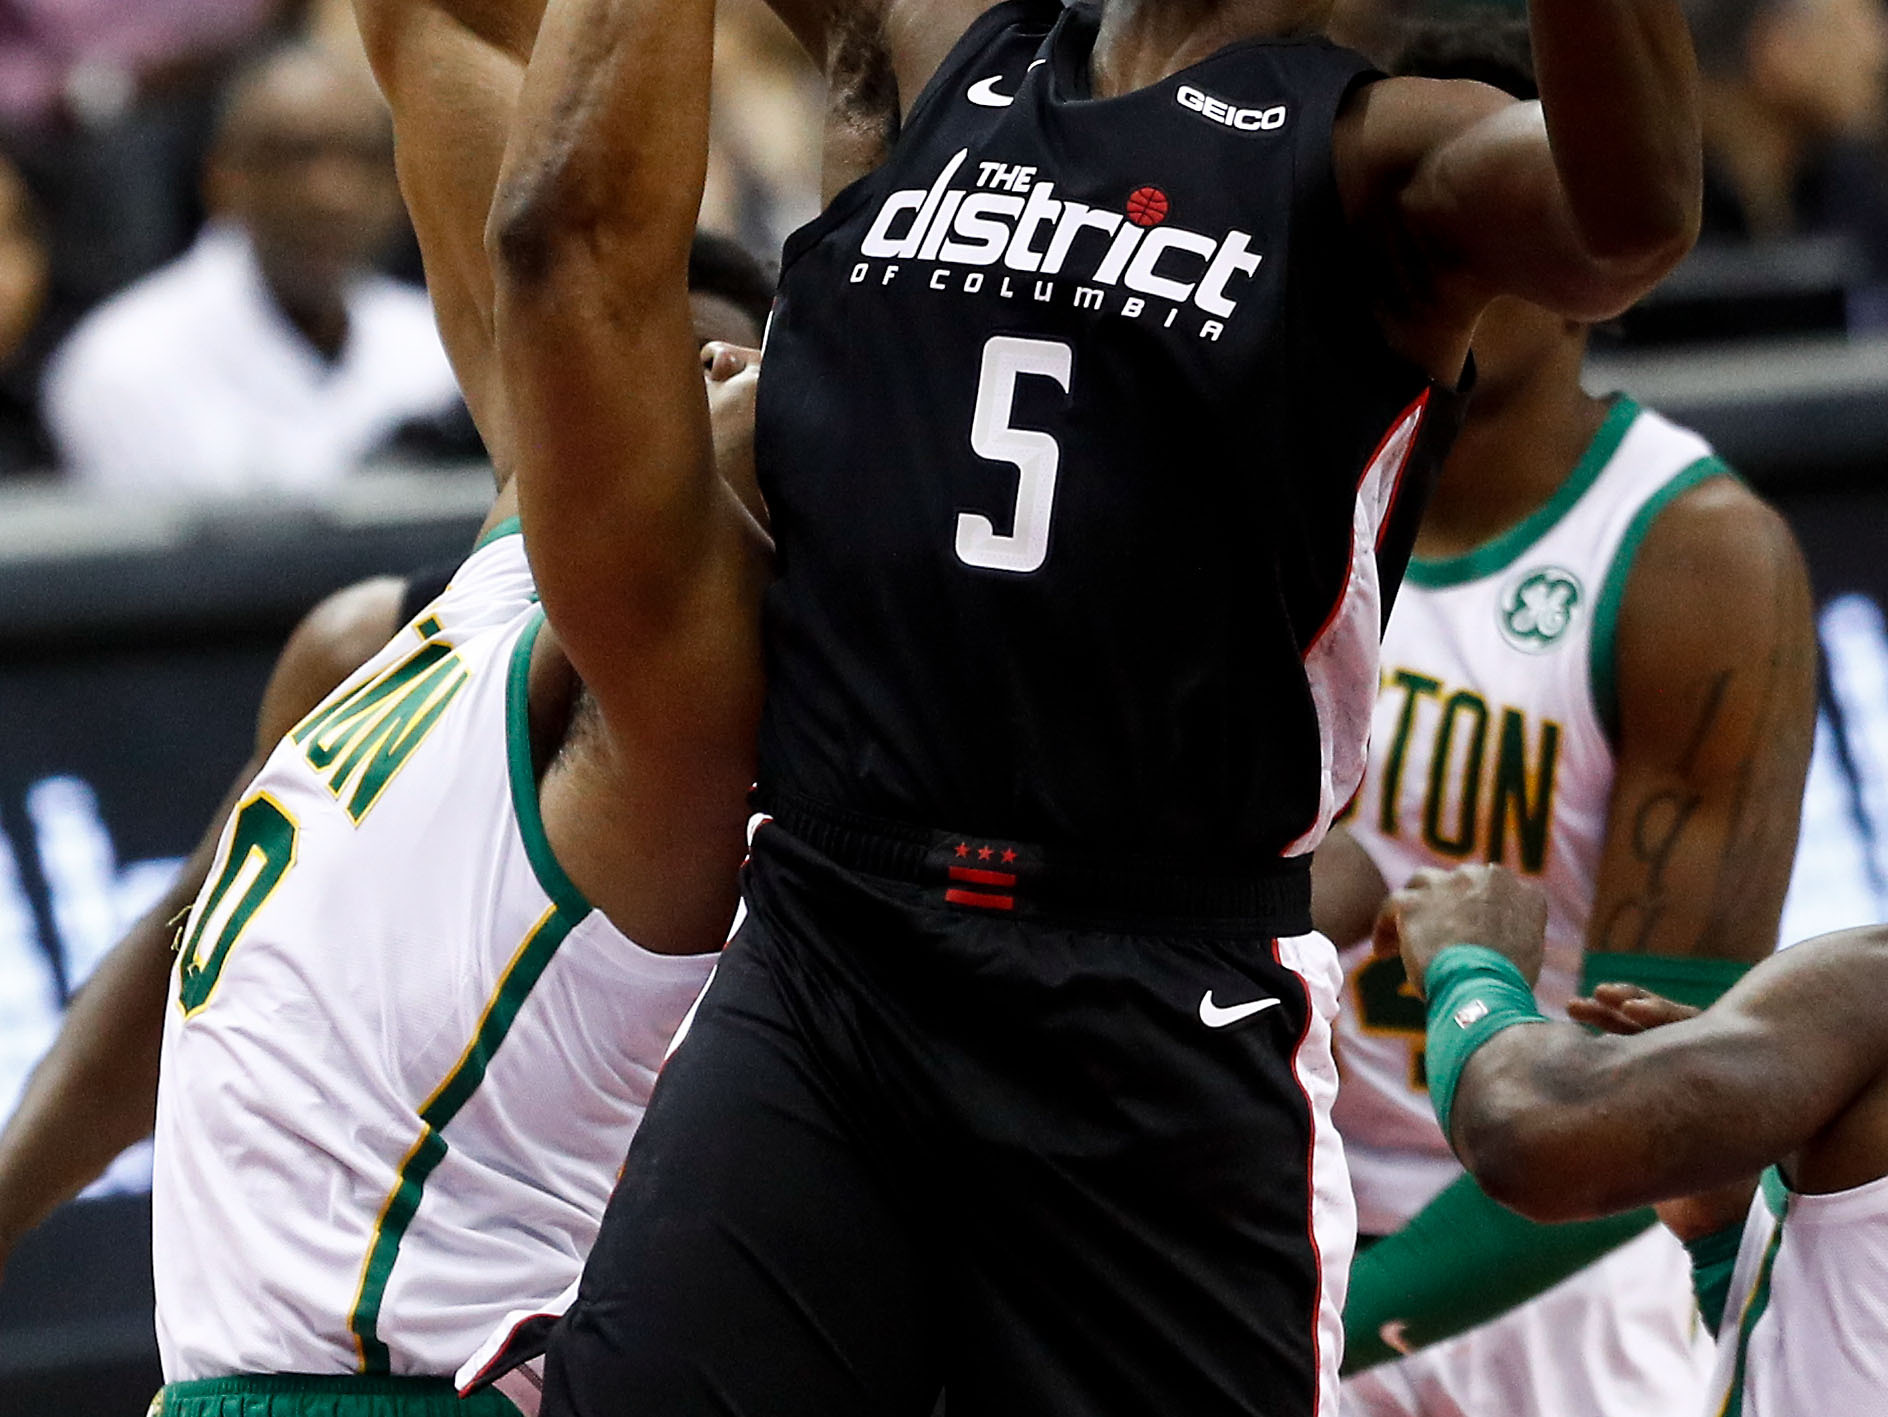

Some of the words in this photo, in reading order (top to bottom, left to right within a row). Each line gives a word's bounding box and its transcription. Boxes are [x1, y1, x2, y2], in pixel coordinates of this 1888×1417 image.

[976, 161, 1037, 192] THE
[1176, 84, 1287, 131] GEICO
[849, 263, 900, 286] OF
[929, 269, 1224, 342] COLUMBIA
[860, 148, 1263, 319] district
[955, 335, 1073, 572] 5
[1374, 664, 1563, 876] TON
[176, 789, 301, 1021] 0
